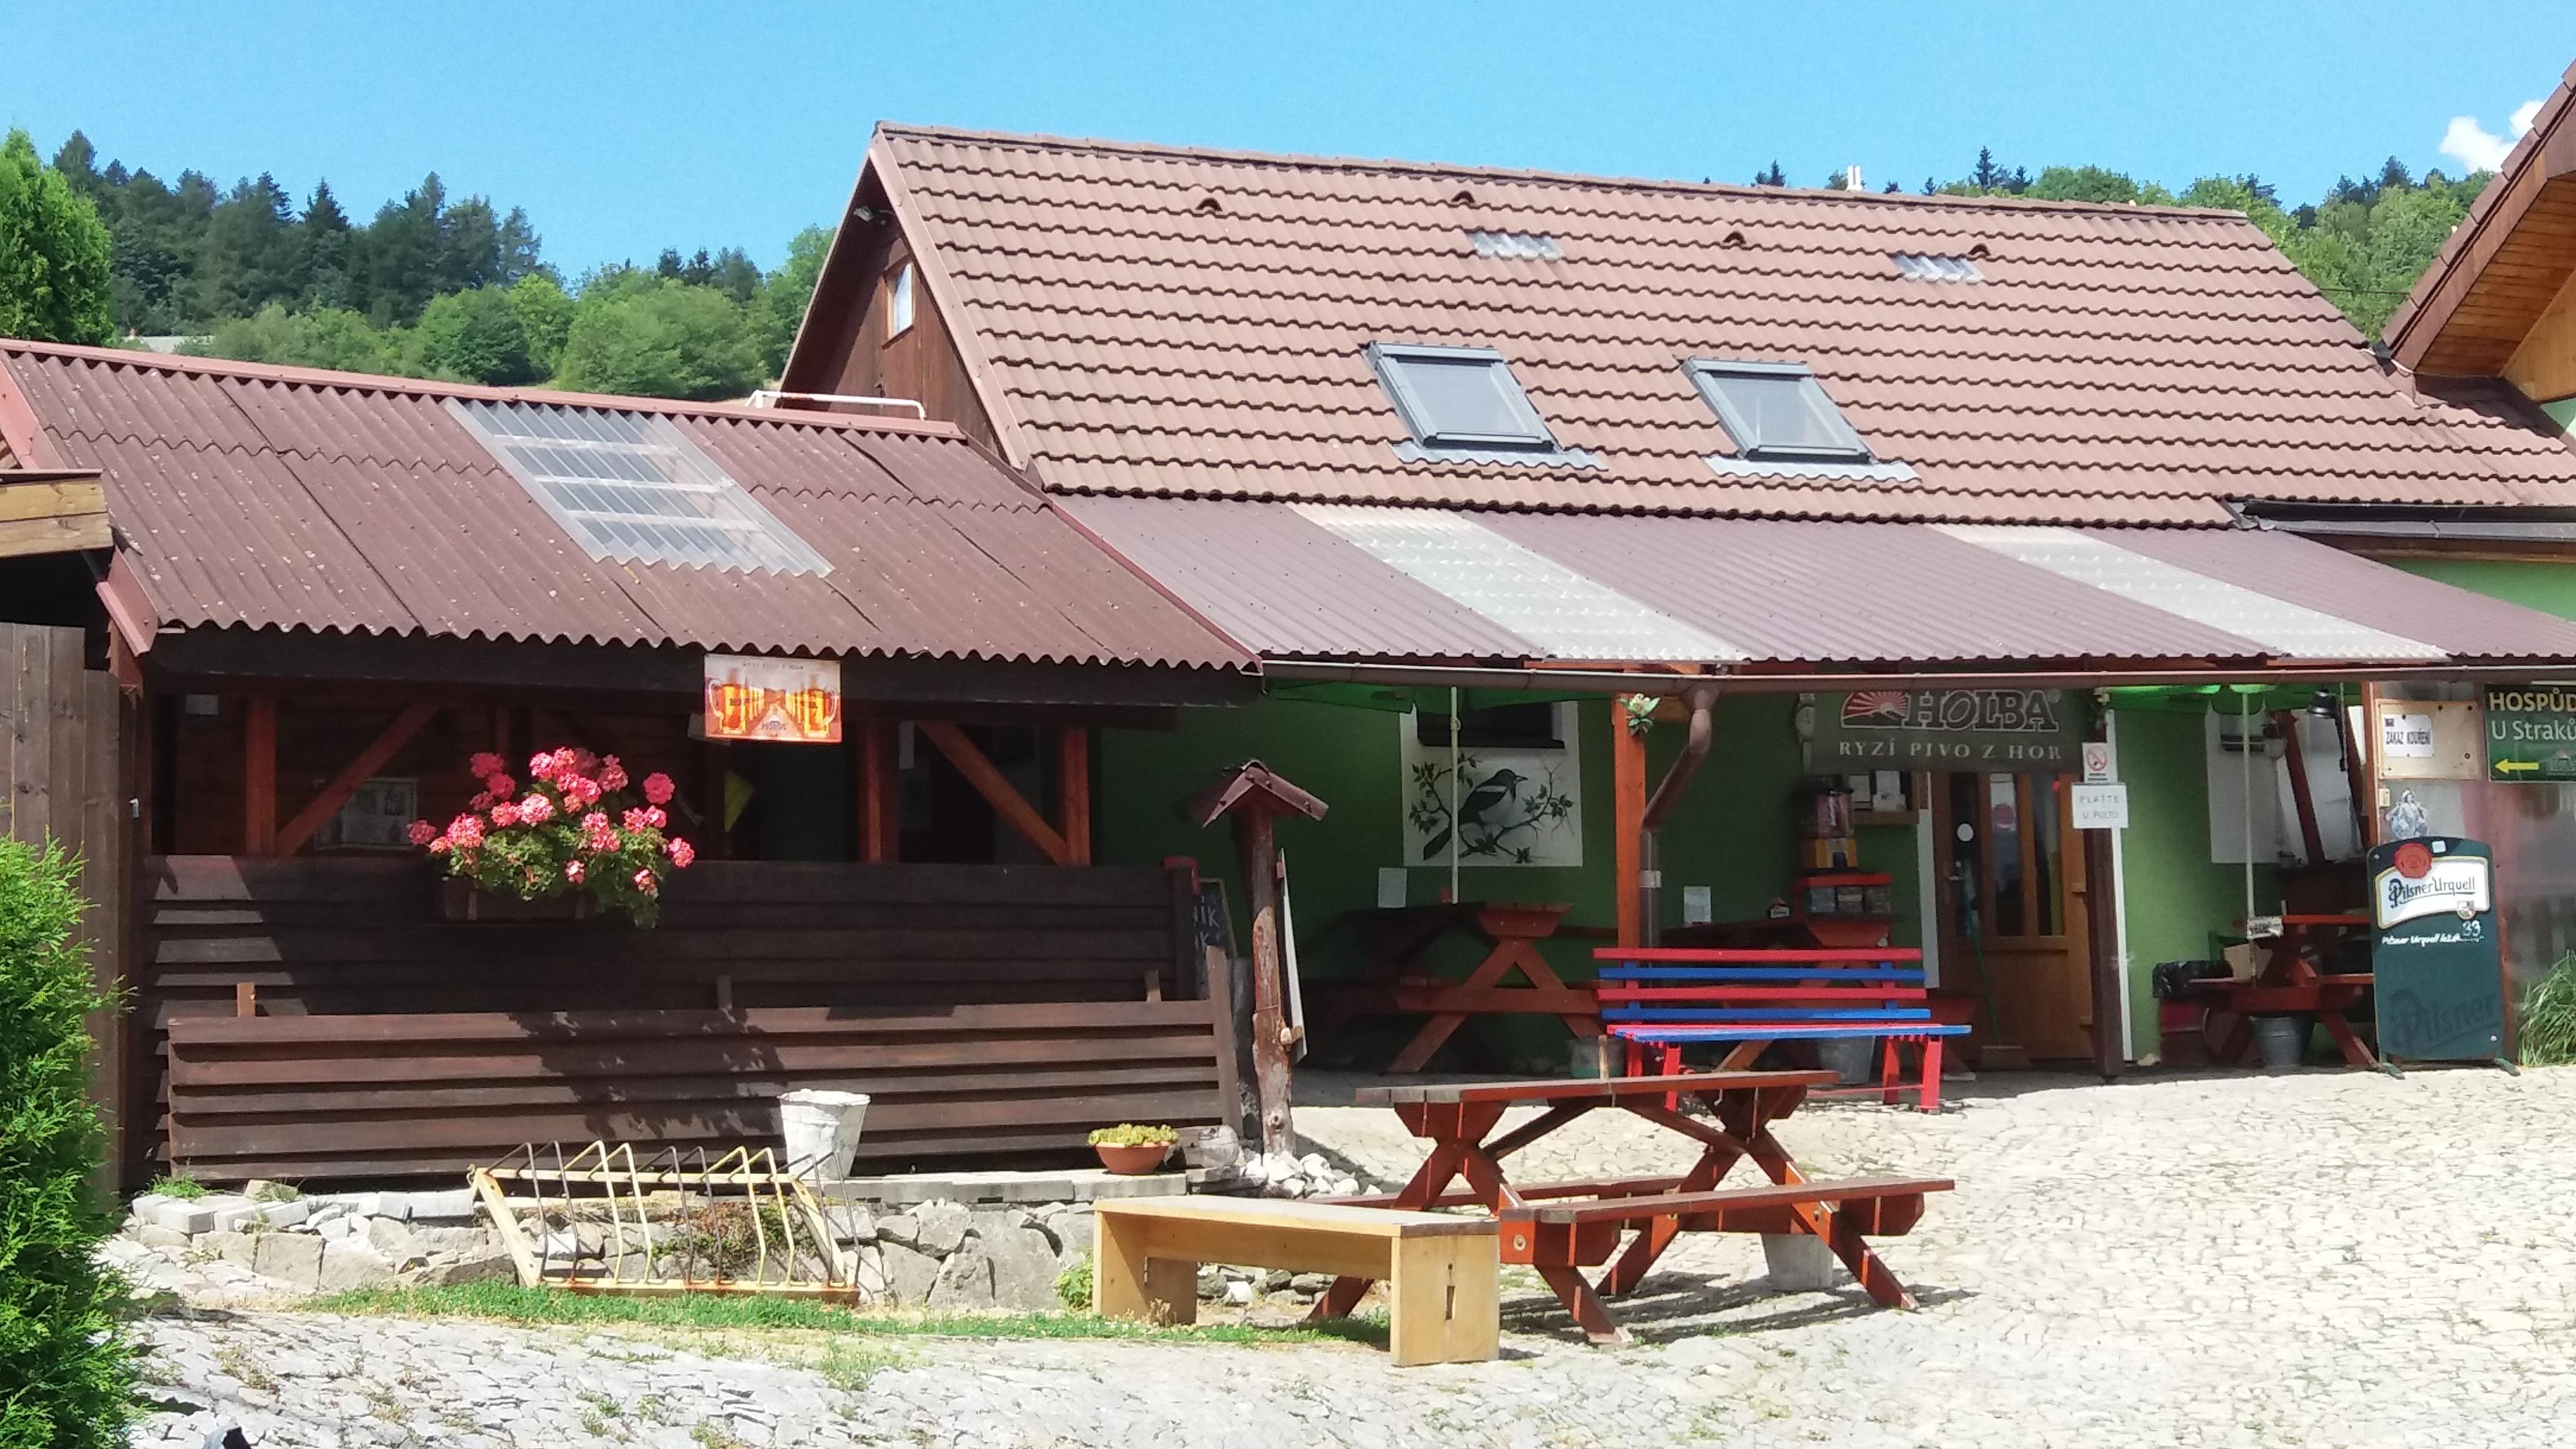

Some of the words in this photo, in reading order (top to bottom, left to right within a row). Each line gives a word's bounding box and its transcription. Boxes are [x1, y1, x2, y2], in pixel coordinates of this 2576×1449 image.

[1900, 690, 2060, 732] HOLBA
[2491, 720, 2506, 740] U
[1839, 738, 1895, 756] RYZÍ
[1909, 742, 1971, 757] PIVO
[1983, 744, 1995, 759] Z
[2009, 744, 2061, 760] HOR
[2388, 878, 2433, 909] Pilsner
[2432, 876, 2476, 896] Urquell
